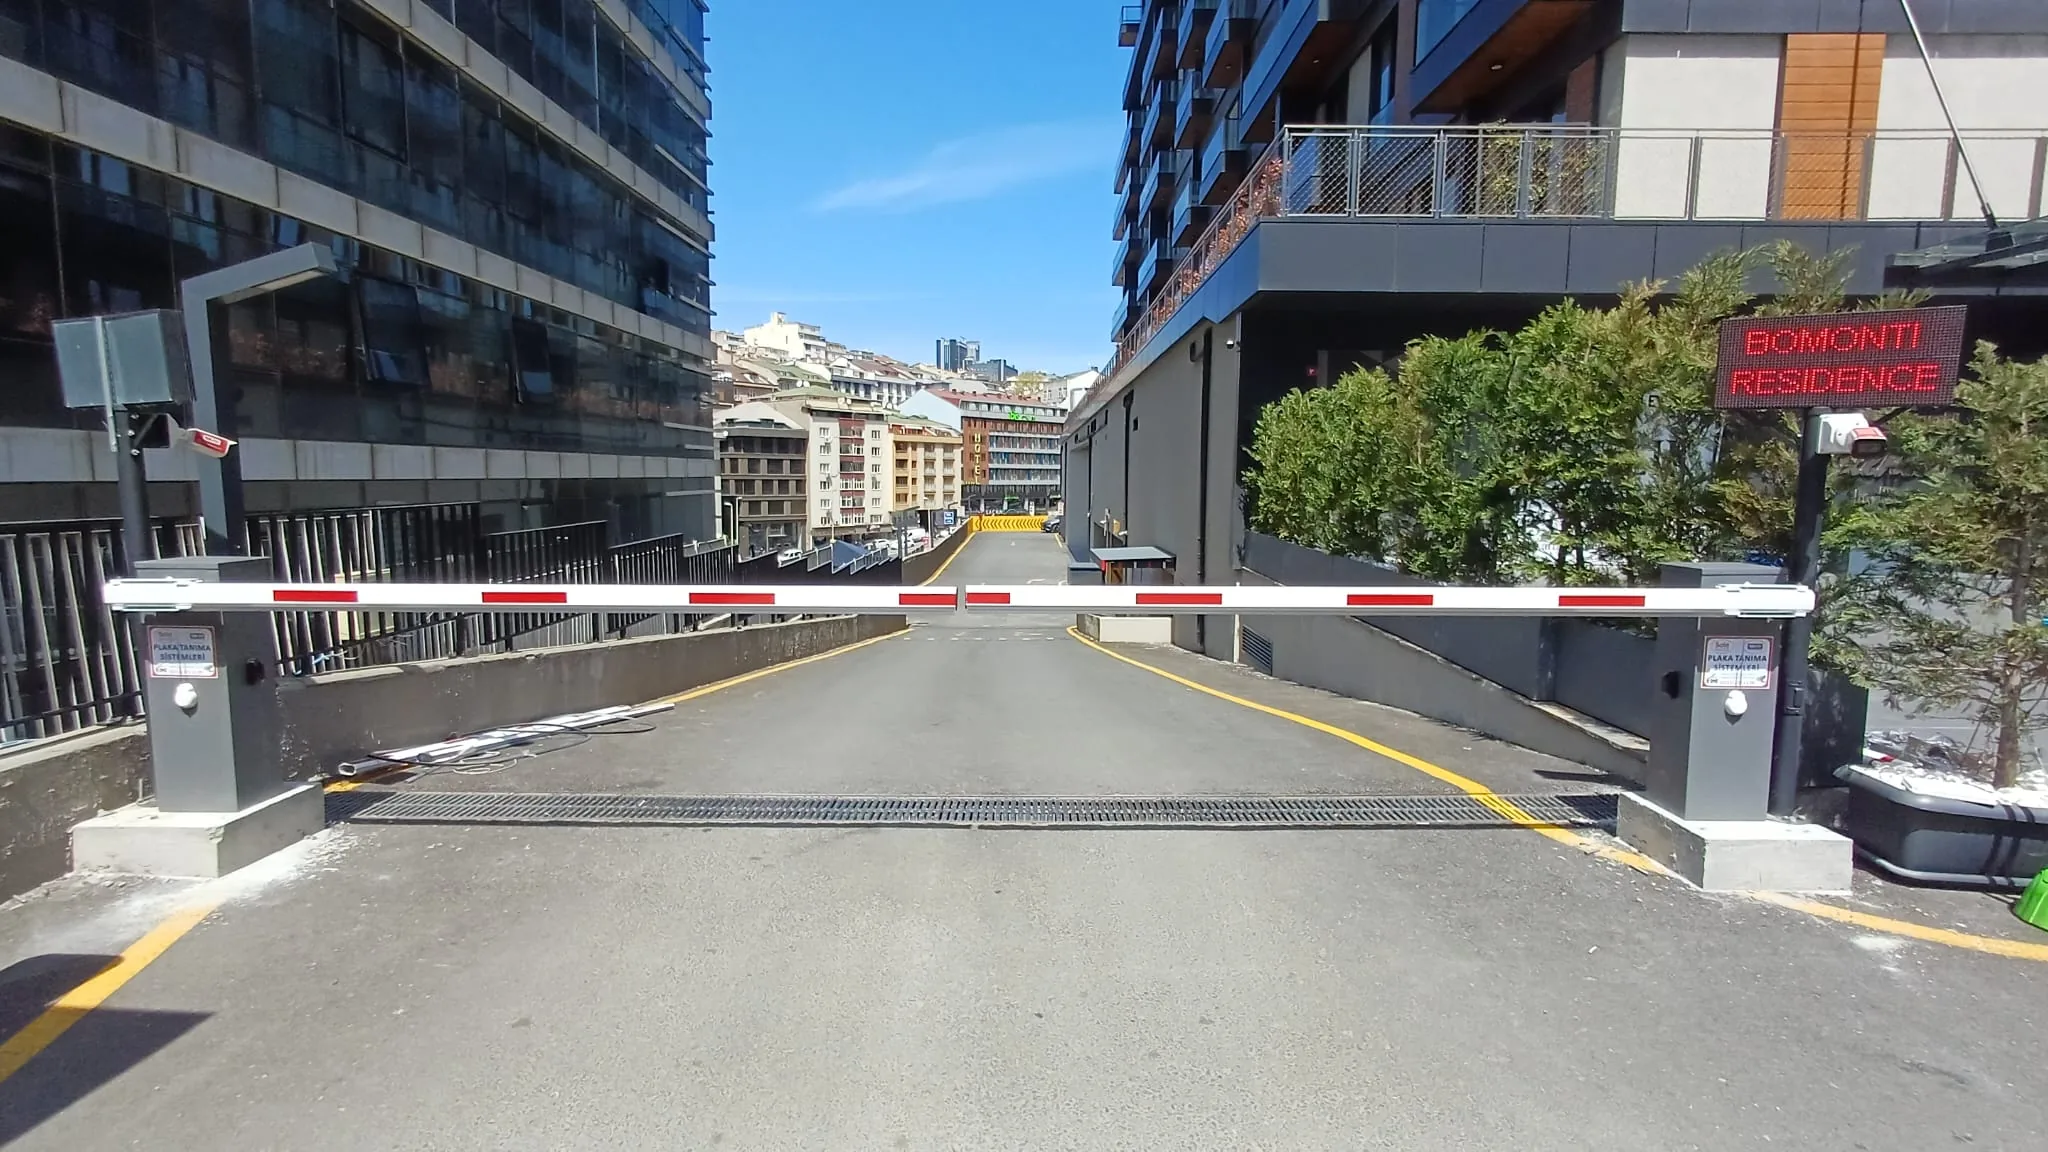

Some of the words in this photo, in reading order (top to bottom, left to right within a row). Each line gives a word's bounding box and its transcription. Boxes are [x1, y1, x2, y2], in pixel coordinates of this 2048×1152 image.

[1745, 320, 1922, 355] BOMONTI
[1731, 364, 1939, 395] RESIDENCE
[179, 644, 211, 652] TANIMA
[1708, 654, 1733, 662] PLAKA
